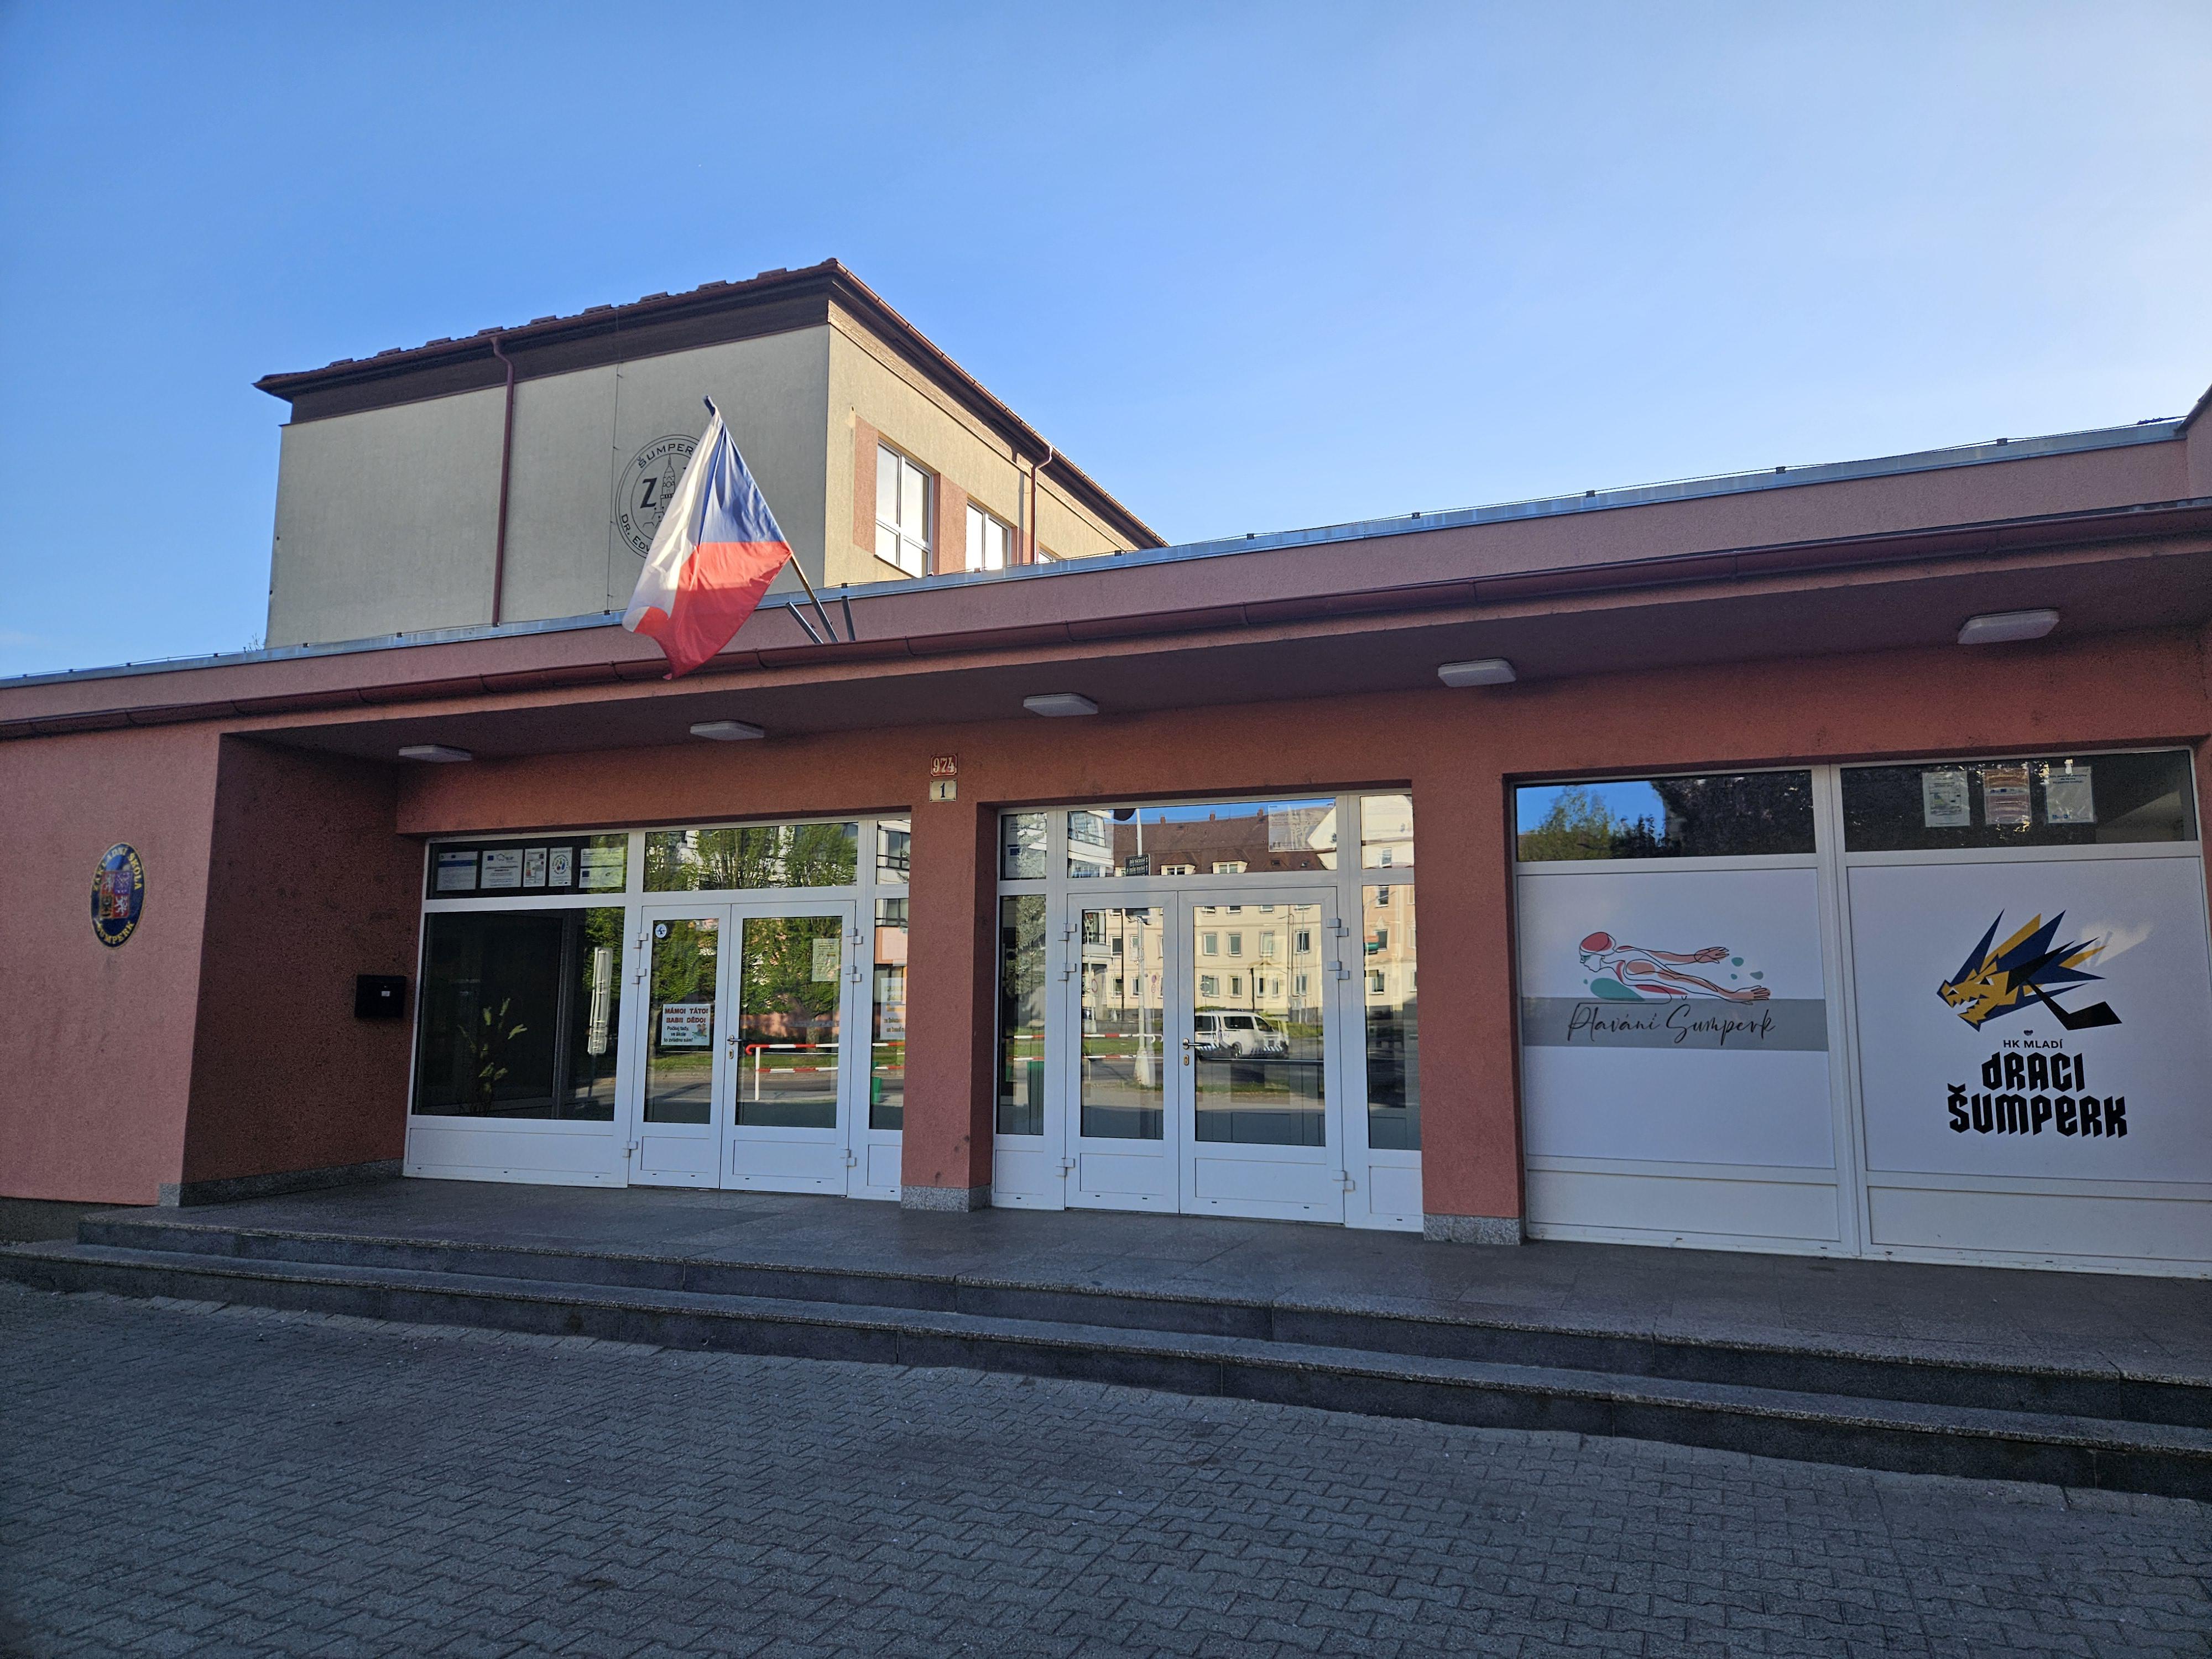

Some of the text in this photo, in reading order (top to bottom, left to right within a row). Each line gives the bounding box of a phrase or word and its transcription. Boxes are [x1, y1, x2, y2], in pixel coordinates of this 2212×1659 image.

[637, 444, 693, 468] ŠUMPER
[622, 514, 630, 535] DR.
[933, 757, 954, 773] 974
[940, 783, 945, 798] 1
[1567, 995, 1776, 1046] Plavání Šumperk
[2004, 1039, 2063, 1048] HK MLADÍ
